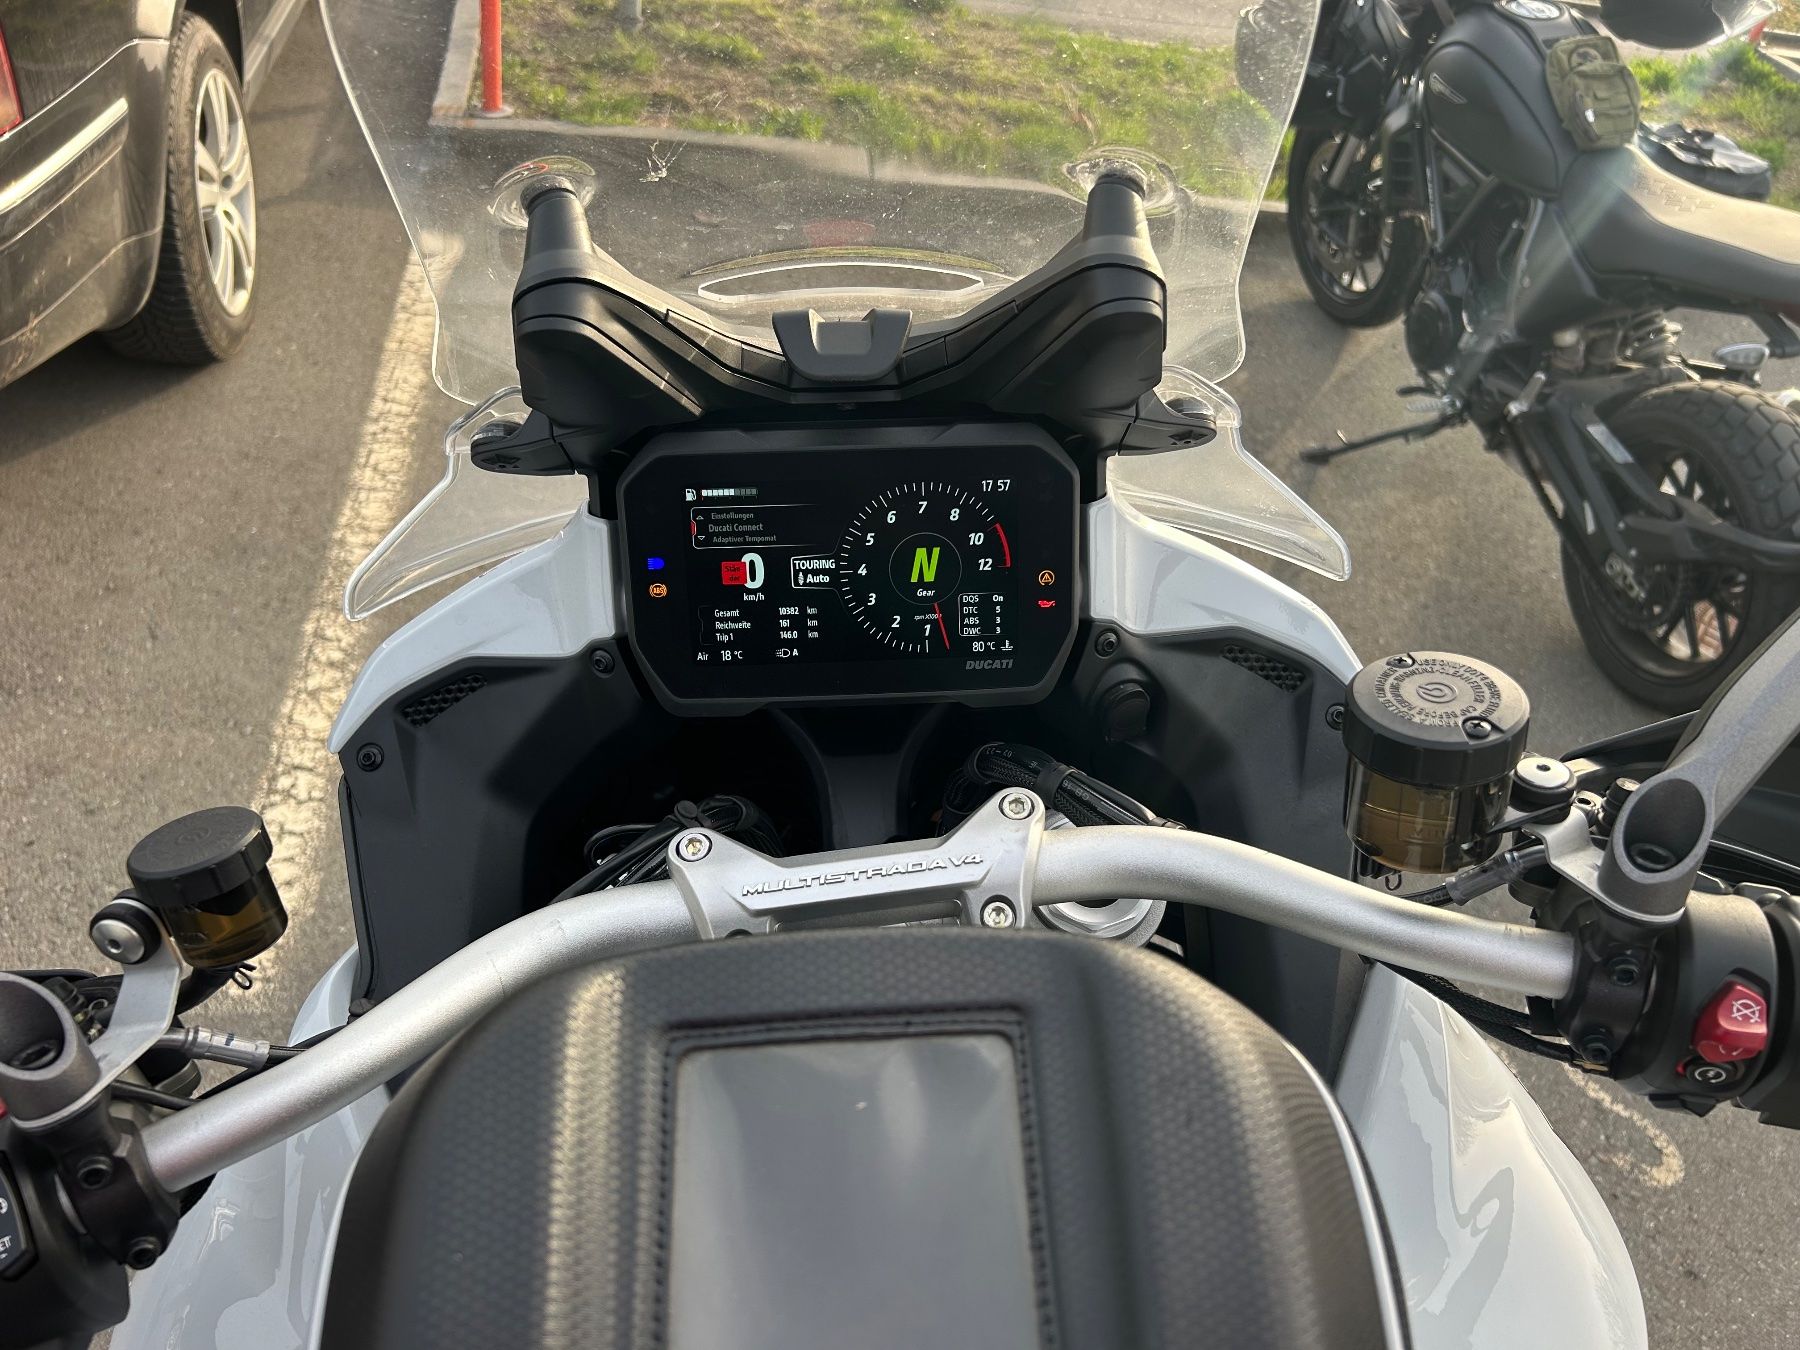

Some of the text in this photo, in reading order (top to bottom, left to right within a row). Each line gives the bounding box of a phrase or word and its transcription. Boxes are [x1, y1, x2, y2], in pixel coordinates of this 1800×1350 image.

[981, 479, 1011, 492] 17 57
[919, 501, 927, 514] 7
[887, 510, 896, 523] 6
[949, 508, 960, 521] 8
[708, 523, 763, 532] Ducati Connect
[866, 533, 875, 545] 5
[969, 533, 984, 545] 10
[794, 559, 835, 569] TOURING
[857, 564, 867, 575] 4
[910, 547, 940, 583] N
[978, 558, 992, 570] 12
[742, 552, 764, 589] 0
[806, 574, 829, 583] Auto
[743, 593, 765, 602] km/h
[917, 588, 935, 597] Gear
[867, 593, 876, 605] 3
[962, 595, 979, 603] DQS
[715, 606, 817, 617] Gesamt 10382 km
[715, 621, 751, 629] Reichweite
[779, 619, 790, 627] 161
[892, 616, 901, 627] 2
[924, 624, 931, 636] 1
[963, 627, 981, 635] DWC
[716, 633, 729, 643] Trip
[730, 633, 733, 641] 1
[780, 631, 797, 639] 146.0
[972, 641, 996, 651] 80 °C
[697, 651, 743, 661] Air 18 °C
[966, 659, 1013, 670] DUCATI
[742, 852, 984, 896] MULTISTRADA V4
